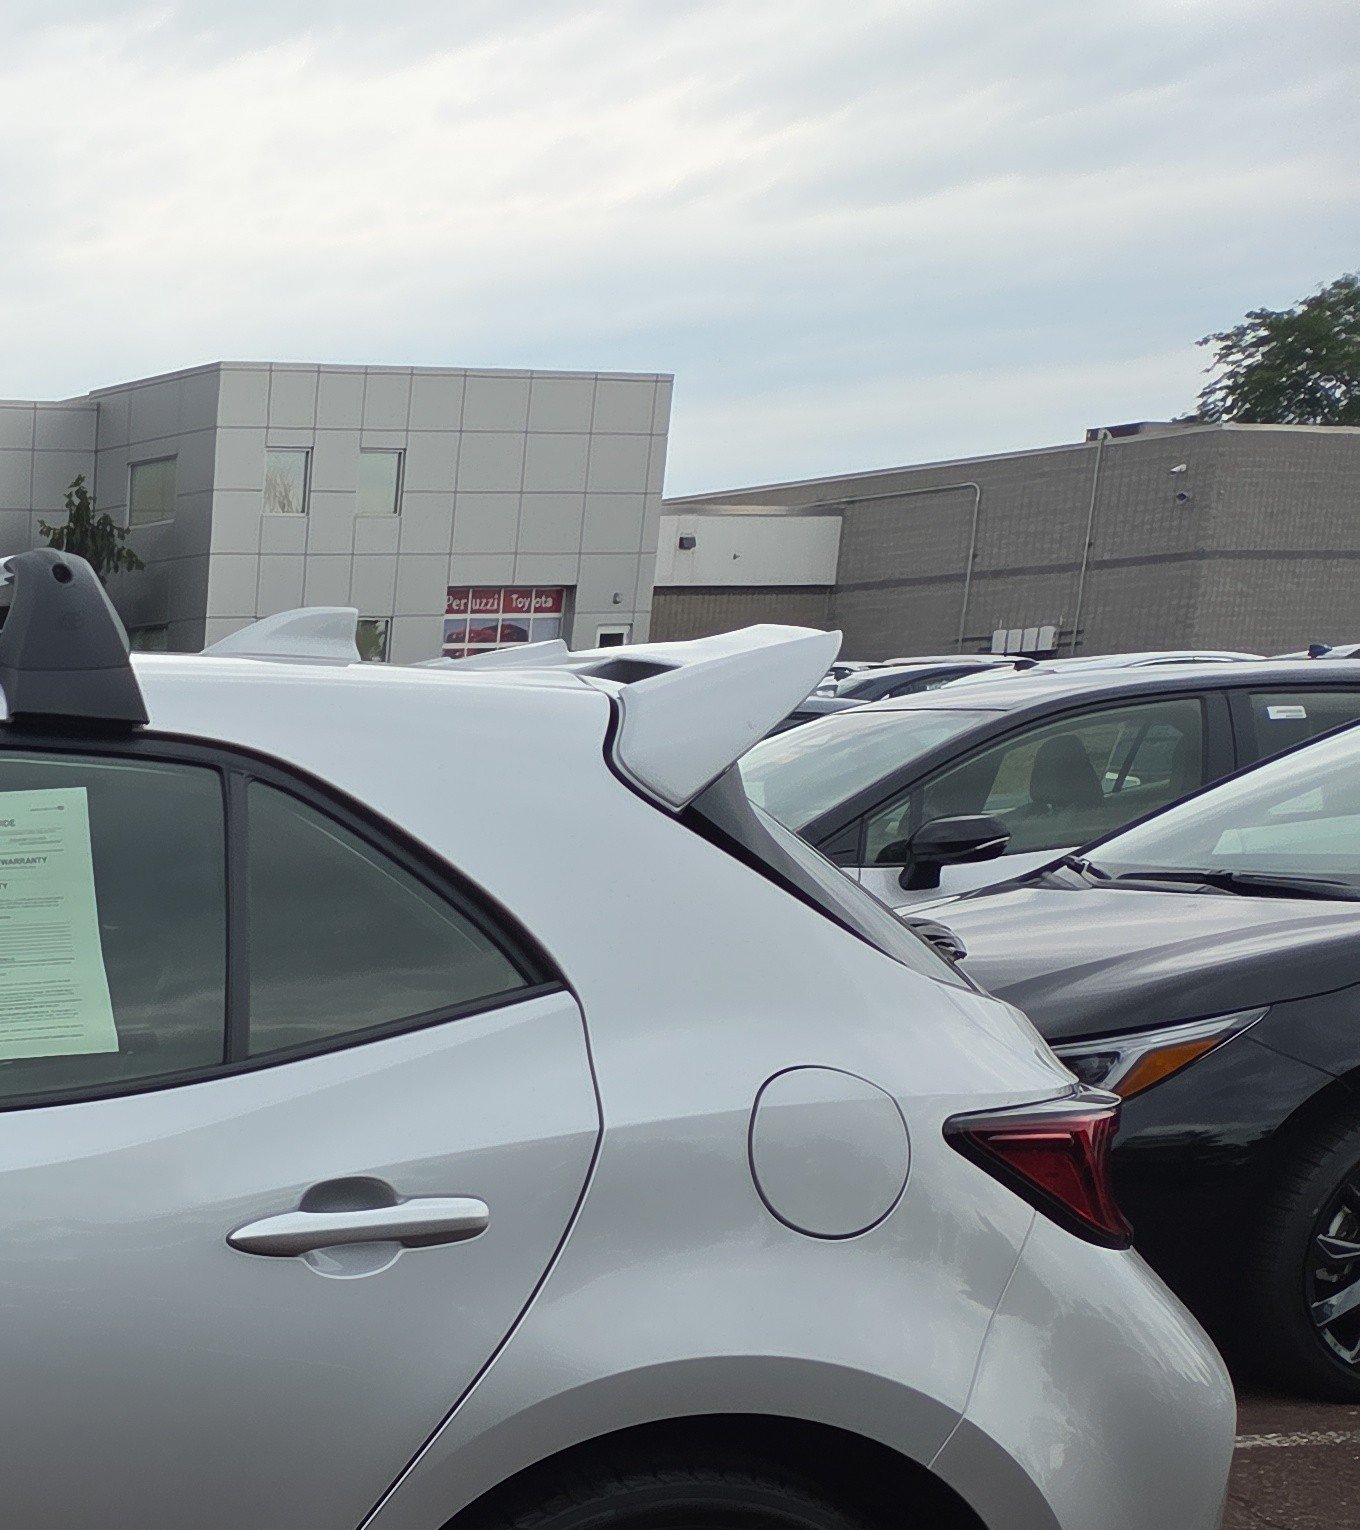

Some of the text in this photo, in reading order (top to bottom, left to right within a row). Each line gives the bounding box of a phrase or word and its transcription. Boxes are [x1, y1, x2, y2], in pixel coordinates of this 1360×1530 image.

[445, 594, 553, 611] Peruzzi Toyota
[0, 856, 48, 866] WARRANTY
